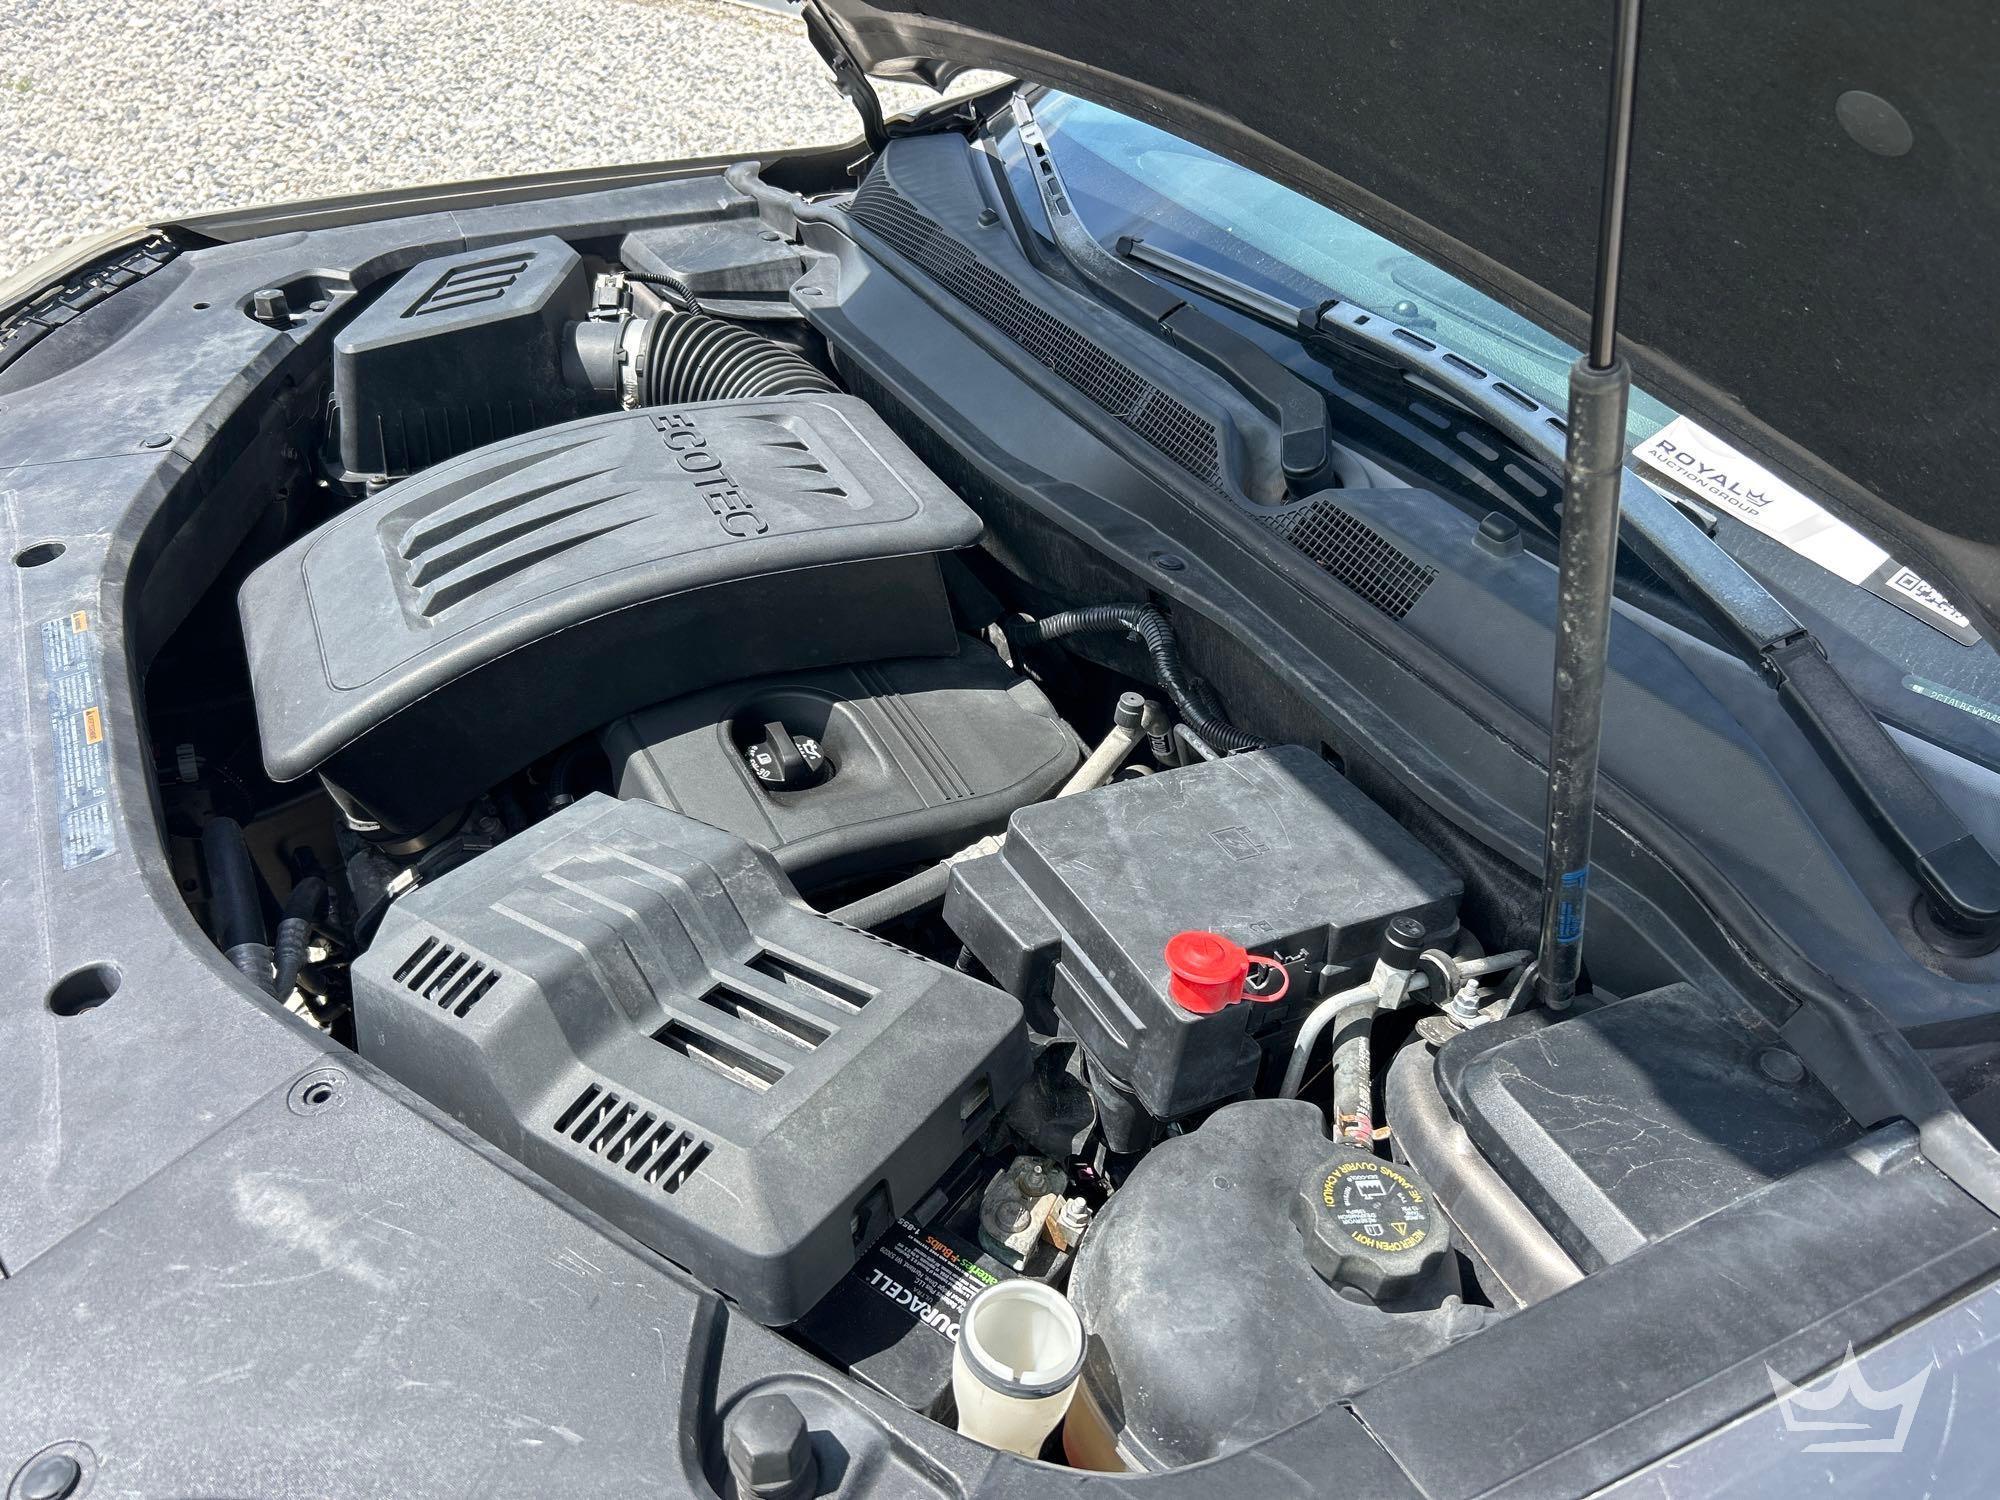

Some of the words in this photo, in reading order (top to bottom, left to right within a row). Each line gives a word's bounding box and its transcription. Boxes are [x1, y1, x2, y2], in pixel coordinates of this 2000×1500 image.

[650, 414, 769, 538] ECOTEC
[1655, 439, 1742, 496] ROYAL
[1648, 449, 1708, 487] AUCTION
[1709, 486, 1759, 516] GROUP
[1339, 1162, 1378, 1173] OUVRIR
[1380, 1167, 1414, 1189] JAMAIS
[1408, 1189, 1423, 1203] NE
[1375, 1241, 1402, 1251] OPEN
[1403, 1229, 1426, 1249] NEVER
[960, 1258, 998, 1285] atteries
[912, 1287, 932, 1302] ULTRA
[924, 1284, 935, 1293] Plus
[870, 1268, 961, 1342] DURACELL
